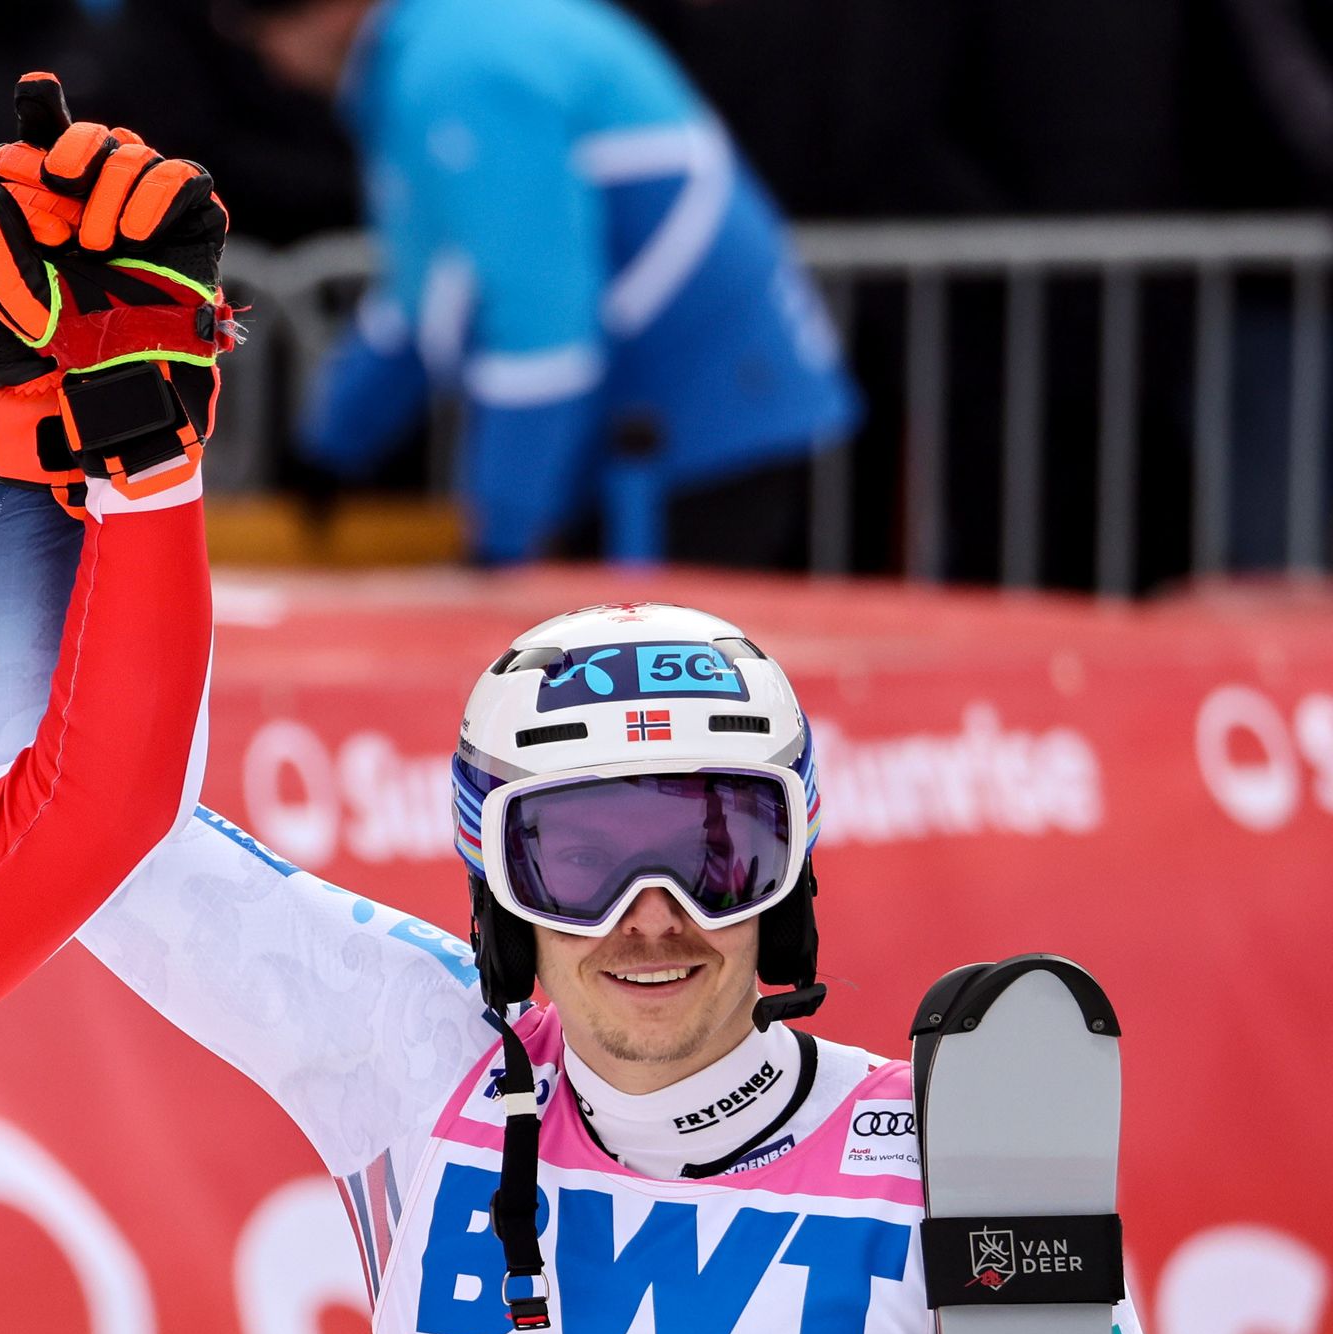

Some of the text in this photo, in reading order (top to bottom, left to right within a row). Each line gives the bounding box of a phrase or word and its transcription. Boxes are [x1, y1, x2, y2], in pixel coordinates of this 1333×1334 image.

[650, 652, 728, 682] 5G
[723, 1142, 792, 1176] YDENBØ
[850, 1147, 871, 1155] Audi
[864, 1154, 878, 1162] Ski
[879, 1153, 904, 1162] World
[1021, 1240, 1069, 1256] VAN
[1022, 1256, 1083, 1274] DEER
